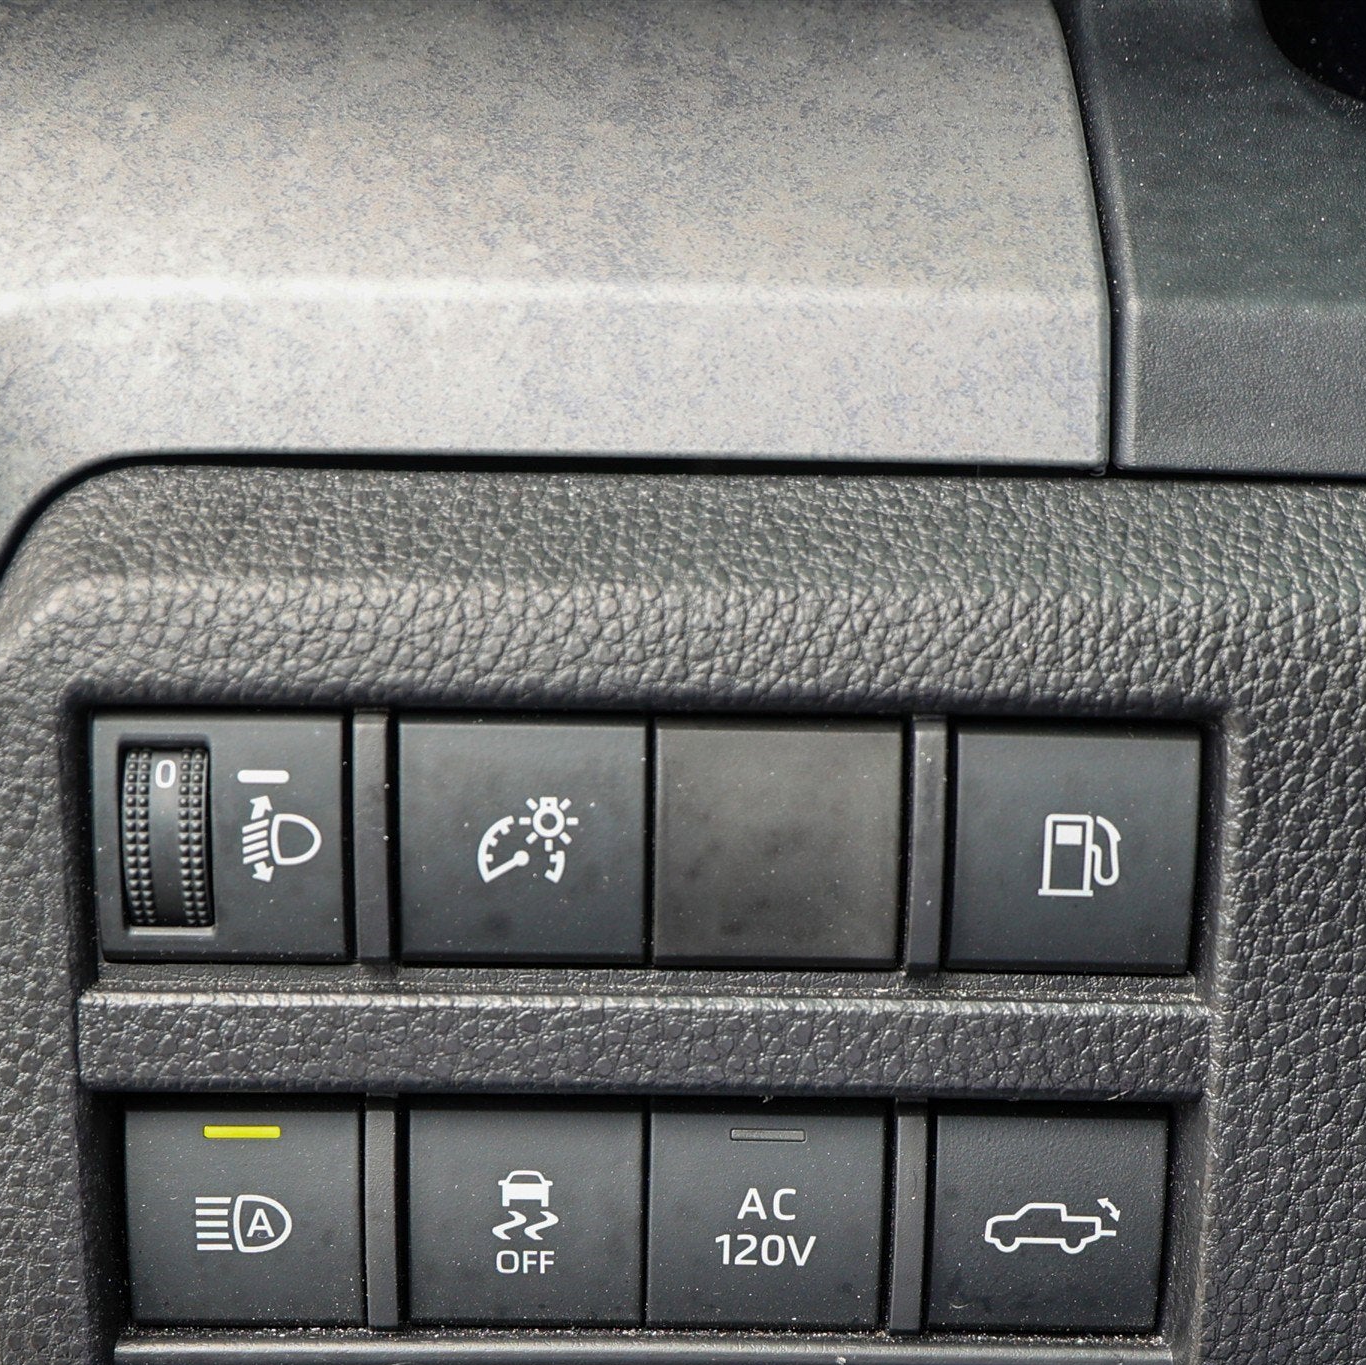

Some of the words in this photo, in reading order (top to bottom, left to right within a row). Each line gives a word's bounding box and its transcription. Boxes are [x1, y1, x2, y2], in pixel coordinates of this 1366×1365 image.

[155, 759, 177, 789] 0
[737, 1188, 798, 1222] AC
[246, 1208, 275, 1238] A
[495, 1250, 556, 1276] OFF
[715, 1234, 818, 1268] 120V
